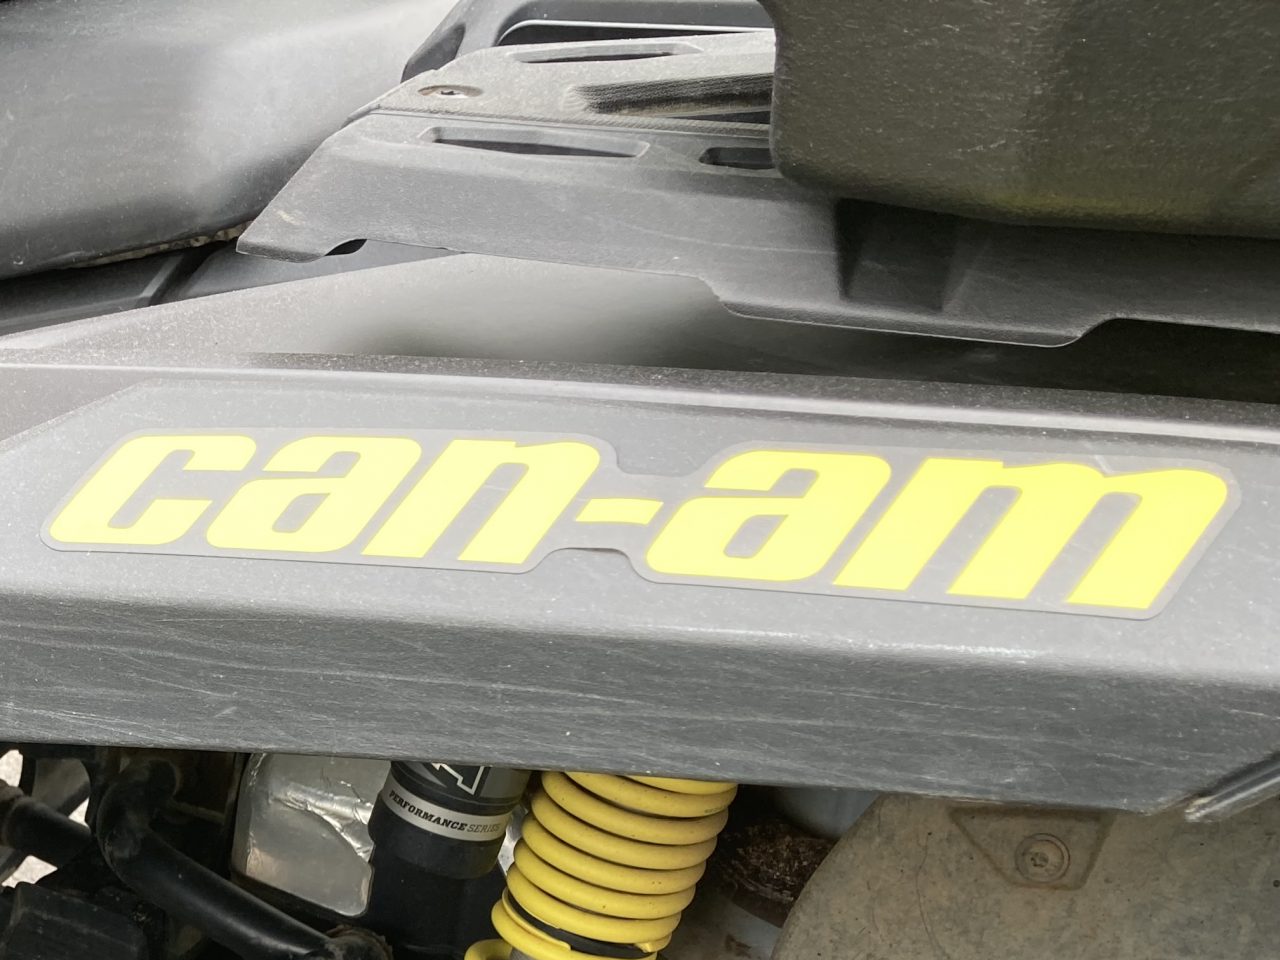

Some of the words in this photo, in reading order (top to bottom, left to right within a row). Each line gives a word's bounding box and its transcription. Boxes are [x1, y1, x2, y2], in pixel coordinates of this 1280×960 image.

[49, 434, 1231, 610] can-am
[388, 789, 469, 832] PERFORMANCE
[467, 823, 502, 834] SERIES
